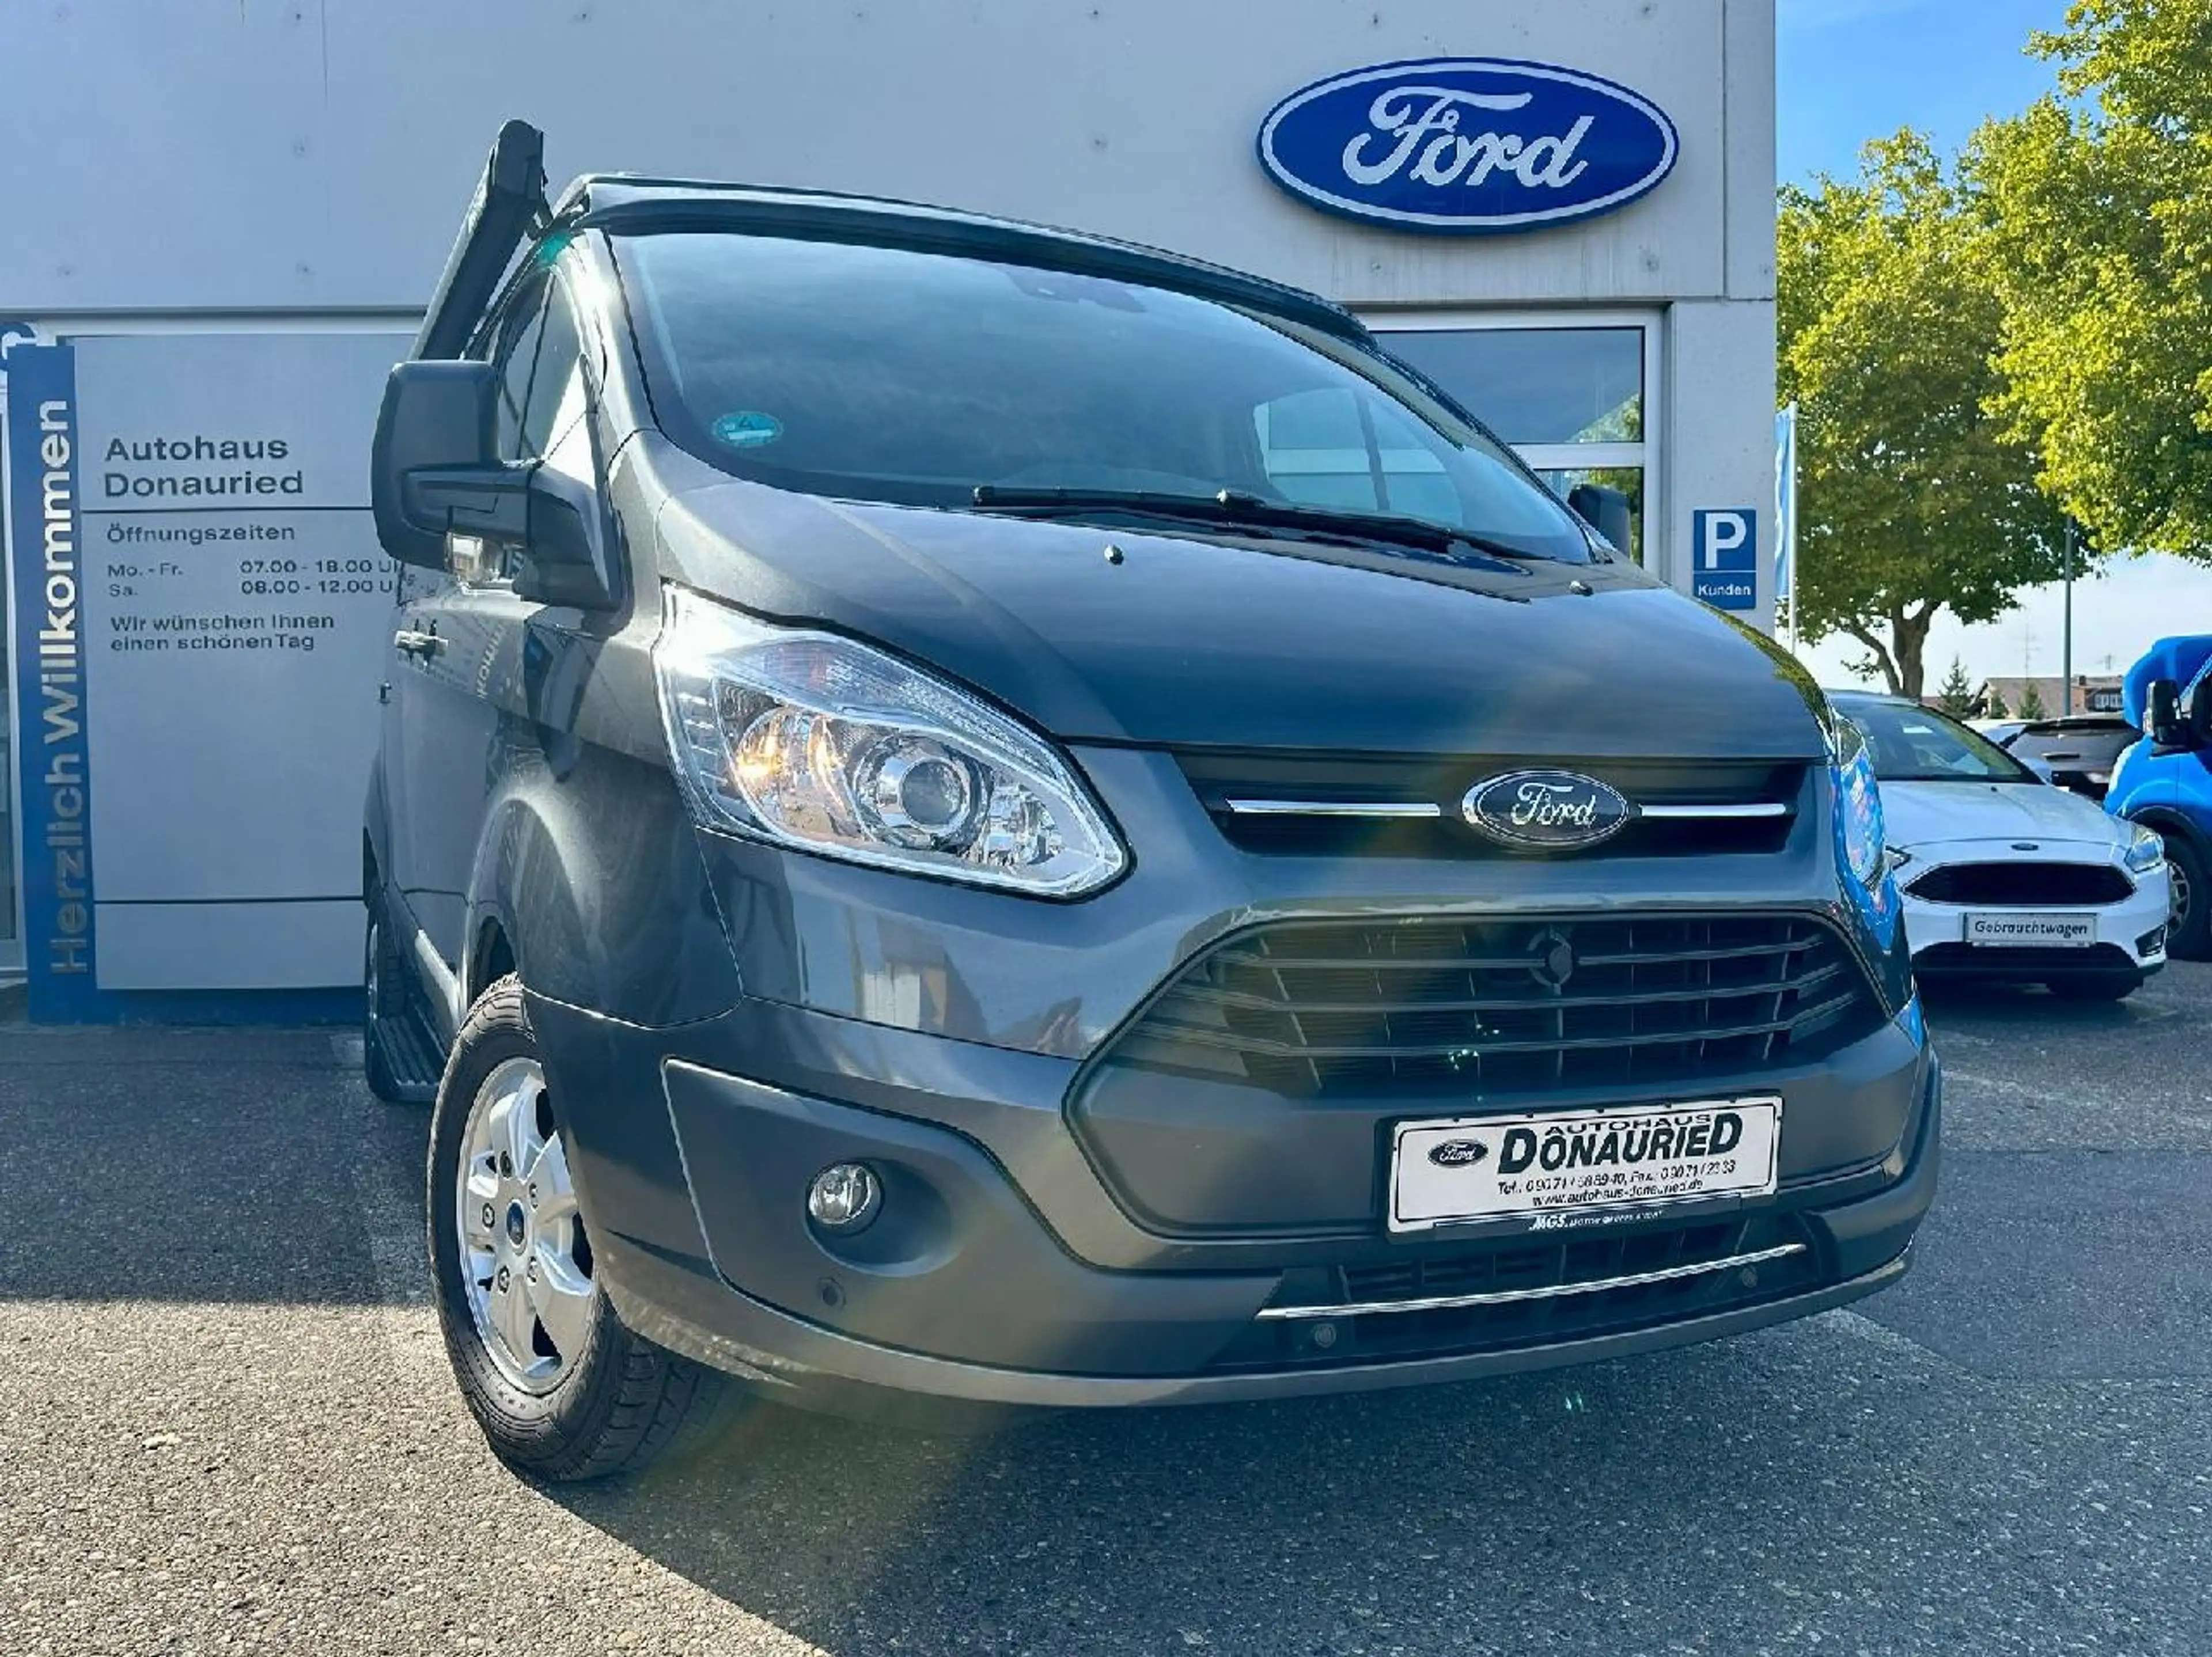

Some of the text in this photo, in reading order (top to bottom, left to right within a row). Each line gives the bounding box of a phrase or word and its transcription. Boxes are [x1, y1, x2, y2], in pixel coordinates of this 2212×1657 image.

[1343, 86, 1594, 188] Ford
[105, 436, 289, 462] Autohaus
[104, 471, 304, 498] Donauried
[107, 522, 295, 545] Öffnungszeiten
[1705, 513, 1747, 569] P
[108, 564, 143, 577] Mo.
[160, 562, 184, 576] Fr.
[240, 560, 297, 574] 07.00
[315, 559, 373, 574] 18.00
[241, 580, 300, 595] 08.00
[319, 579, 374, 594] 12.00
[1698, 583, 1751, 596] Kunden
[111, 614, 335, 631] Wir wünschen Ihnen
[111, 634, 315, 651] einen schönen Tag
[39, 400, 88, 974] Herzlich Willkommen
[1510, 782, 1598, 829] Ford
[1975, 920, 2088, 939] Gebrauchtwagen
[1545, 1114, 1711, 1136] AUTOHAUS
[1497, 1112, 1743, 1174] DONAURIED
